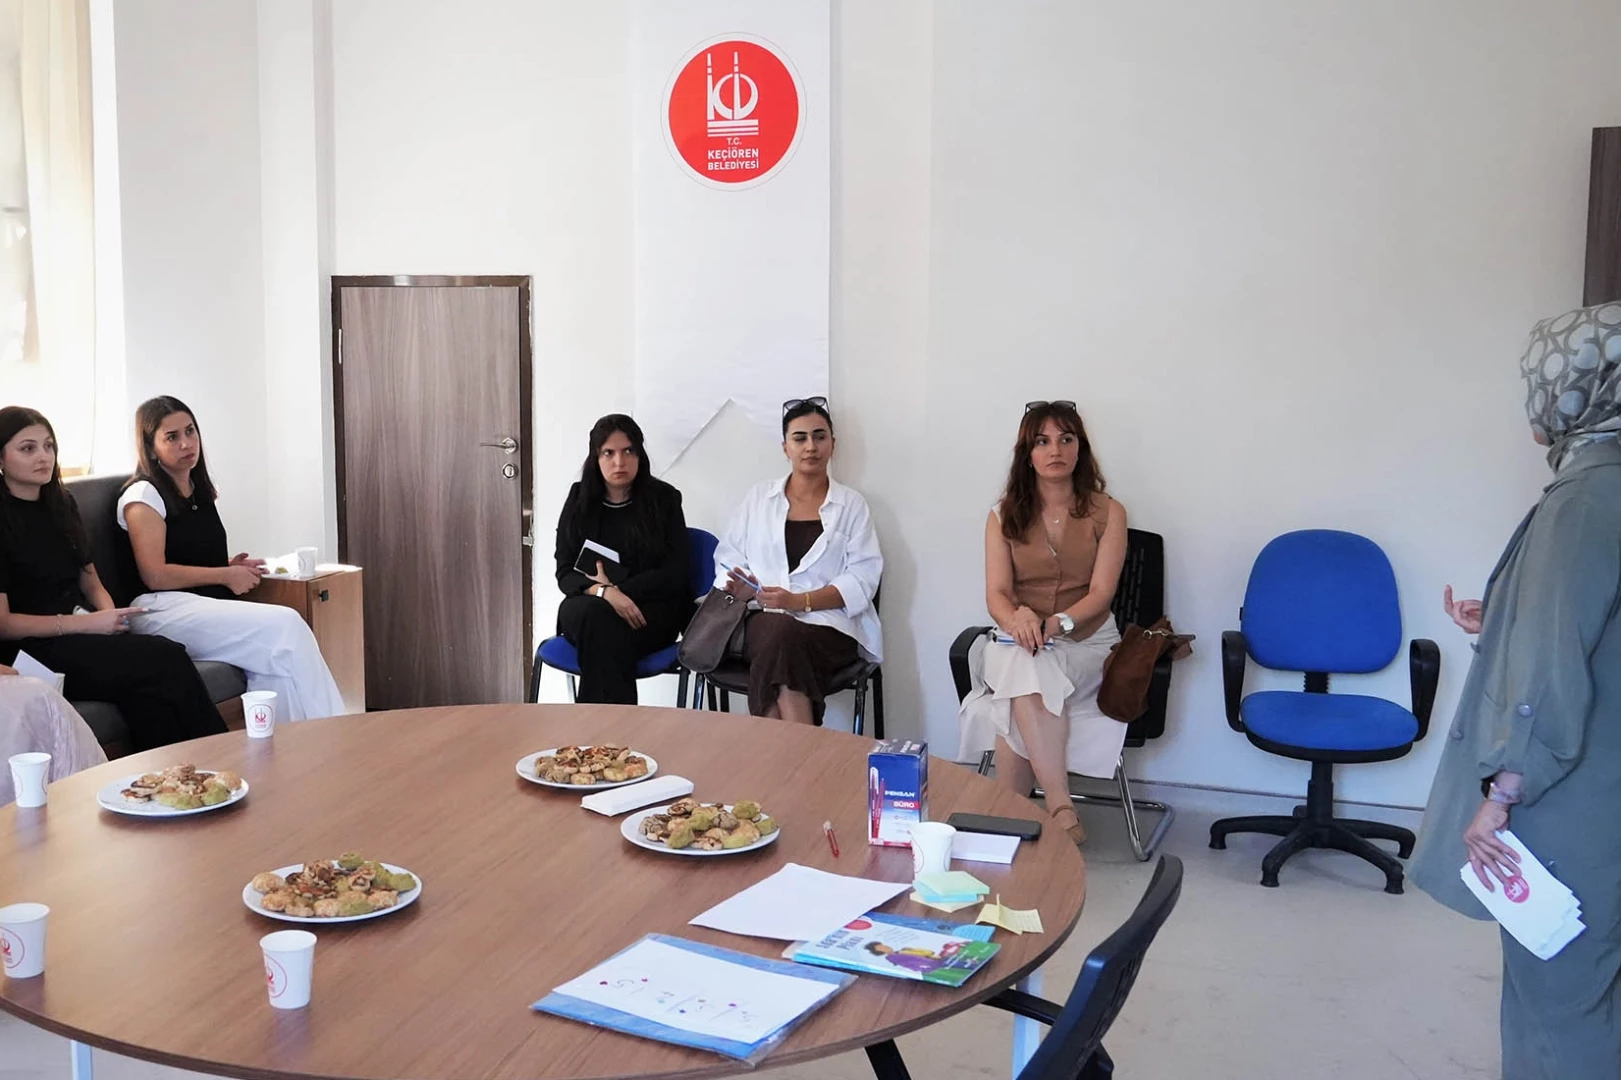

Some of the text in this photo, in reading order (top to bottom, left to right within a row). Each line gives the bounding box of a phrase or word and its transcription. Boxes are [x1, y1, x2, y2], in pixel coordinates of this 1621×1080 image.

[726, 137, 742, 145] T.C.
[707, 147, 759, 161] KEÇİÖREN
[707, 159, 759, 170] BELEDİYESİ
[884, 790, 916, 798] PENSAN
[893, 800, 915, 808] BÜRO
